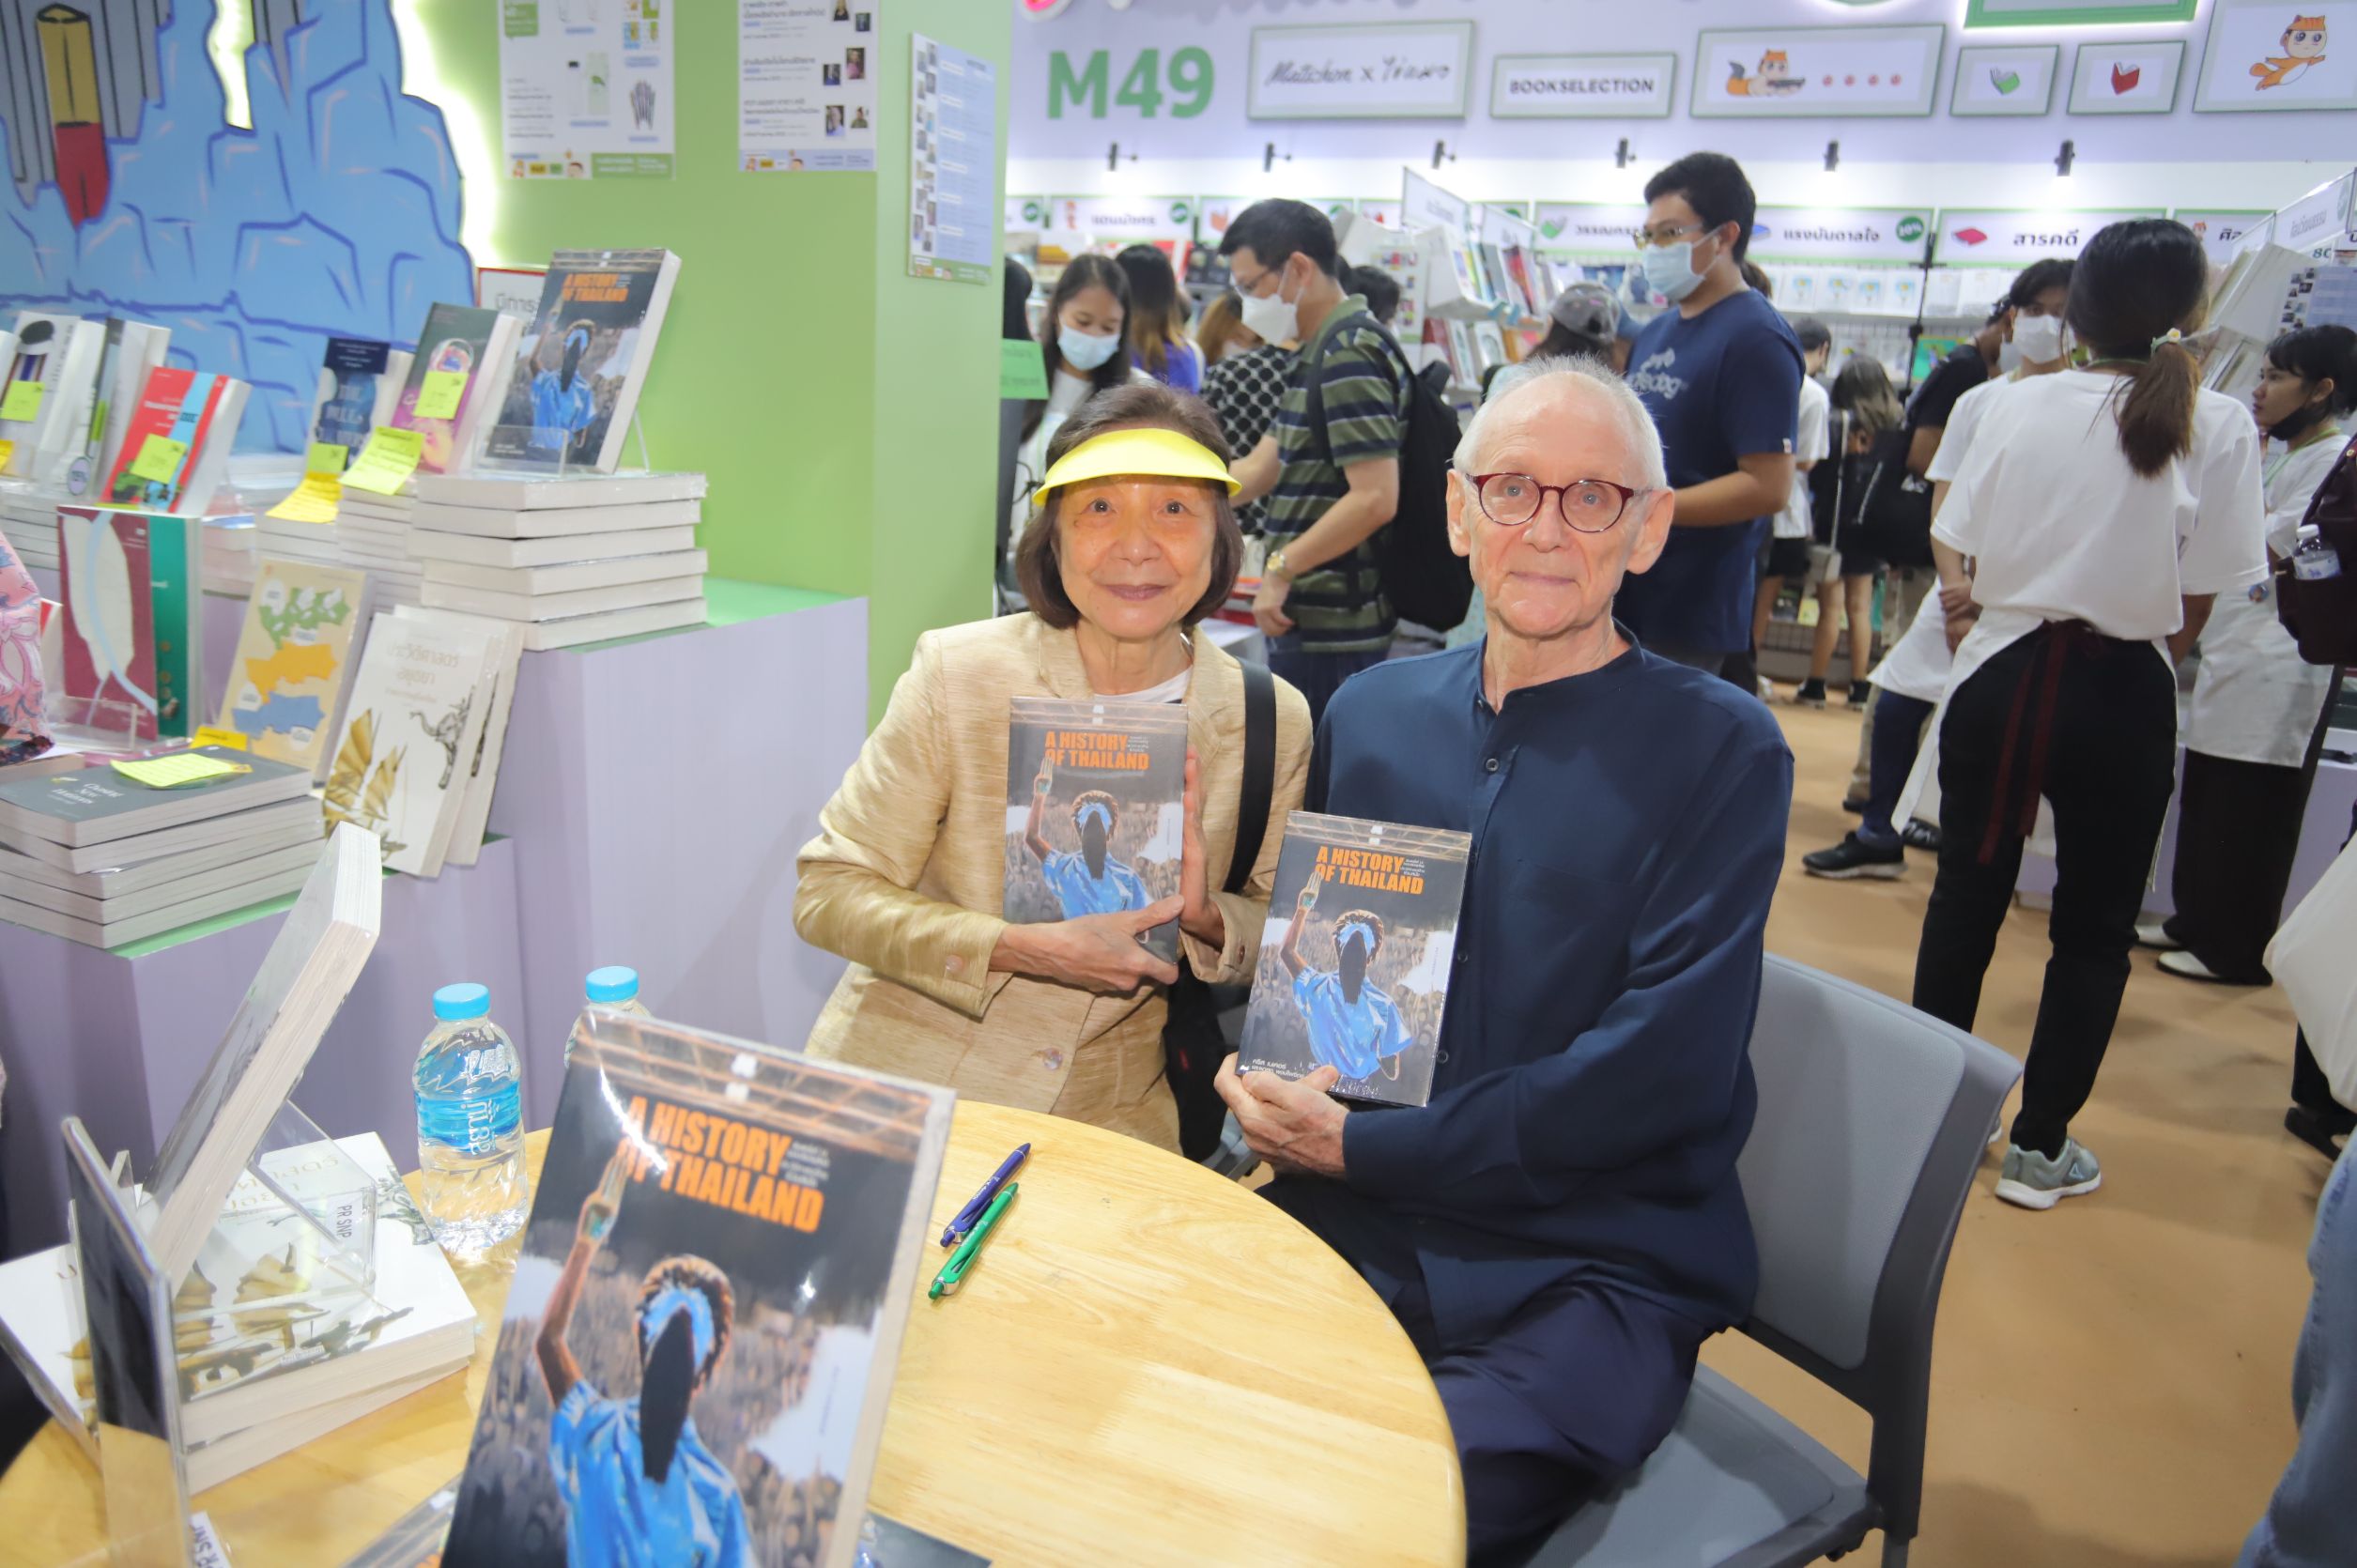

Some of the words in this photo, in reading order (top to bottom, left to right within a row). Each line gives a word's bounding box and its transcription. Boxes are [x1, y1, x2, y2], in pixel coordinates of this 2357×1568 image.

[1046, 45, 1215, 120] M49
[1509, 77, 1655, 95] BOOKSELECTION
[2012, 229, 2079, 247] สารคดี
[1044, 730, 1056, 748] A
[1059, 730, 1128, 751] HISTORY
[1044, 748, 1065, 766] OF
[1069, 750, 1150, 770] THAILAND
[1316, 845, 1329, 864] A
[1331, 847, 1406, 873] HISTORY
[1315, 863, 1337, 883] OF
[1339, 867, 1425, 895] THAILAND
[648, 1101, 793, 1177] HISTORY
[659, 1147, 825, 1234] THAILAND
[337, 1205, 353, 1217] PR
[336, 1218, 353, 1238] SNP
